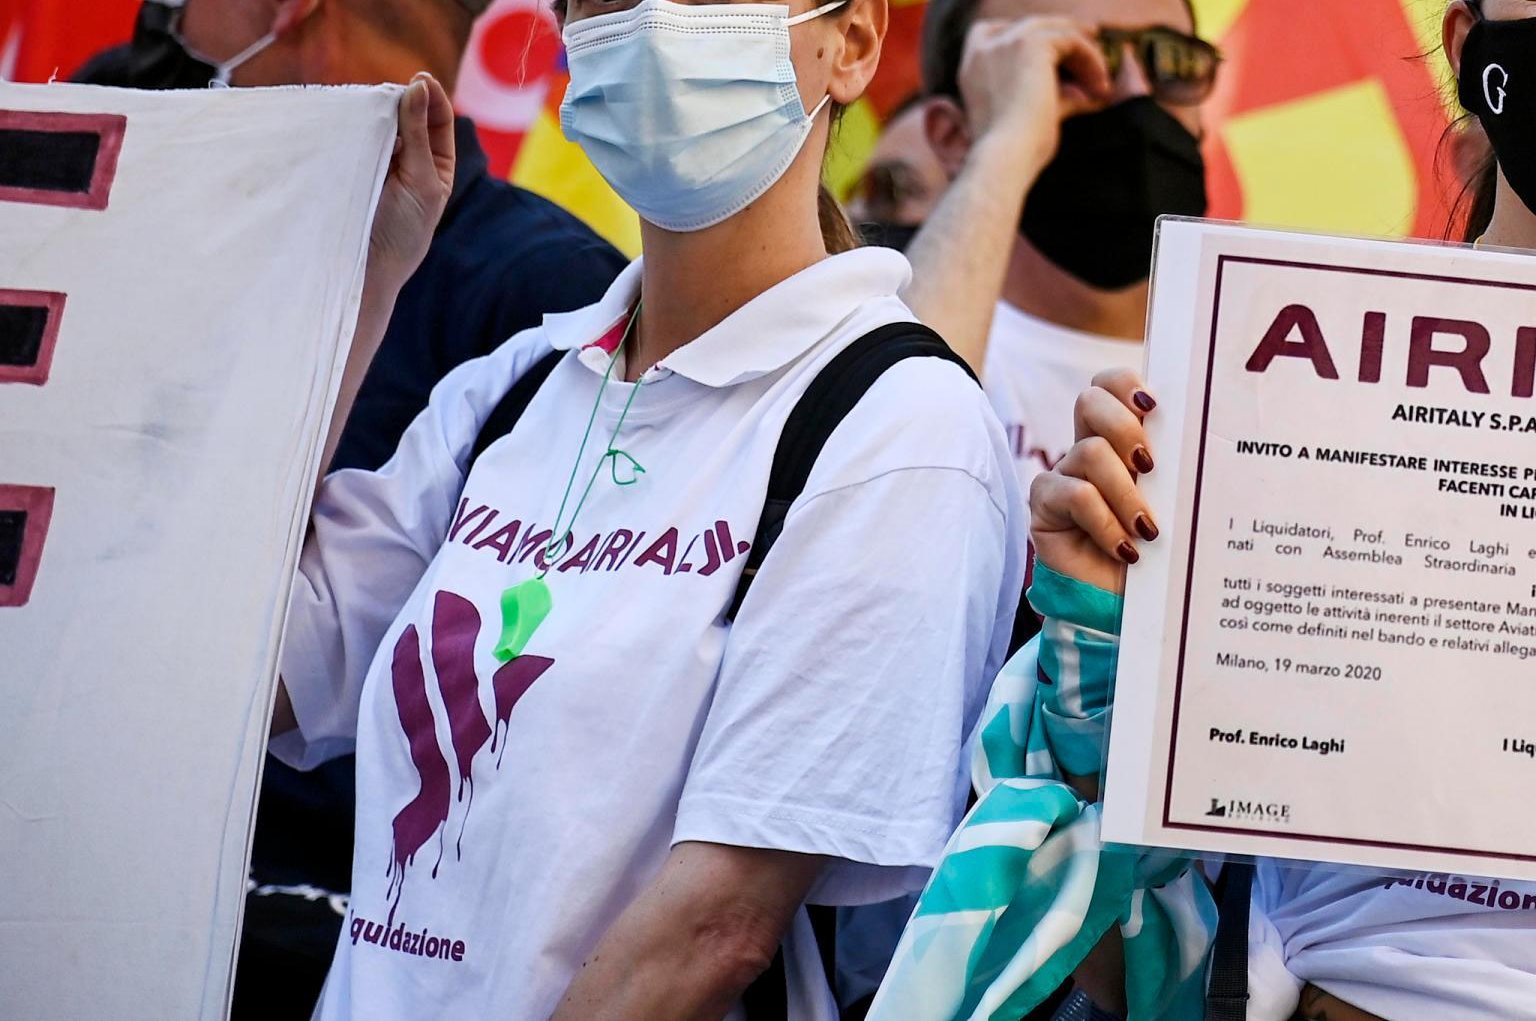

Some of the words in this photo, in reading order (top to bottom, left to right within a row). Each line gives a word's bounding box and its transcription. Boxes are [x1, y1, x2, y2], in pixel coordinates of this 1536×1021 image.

[1390, 403, 1486, 429] AIRITALY
[1235, 439, 1293, 459] INVITO
[1296, 445, 1310, 460] A
[1314, 446, 1428, 472] MANIFESTARE
[1432, 457, 1519, 480] INTERESSE
[1437, 477, 1506, 498] FACENTI
[1499, 502, 1519, 519] IN
[1228, 516, 1234, 531] I
[1251, 518, 1335, 542] Liquidatori,
[1352, 527, 1384, 545] Prof.
[1403, 532, 1451, 552] Enrico
[1468, 539, 1510, 560] Laghi
[1226, 538, 1255, 552] nati
[1274, 543, 1303, 556] con
[1321, 544, 1403, 566] Assemblea
[1423, 553, 1517, 577] Straordinaria
[1222, 576, 1252, 591] tutti
[1255, 581, 1262, 592] i
[1265, 581, 1327, 600] soggetti
[1330, 587, 1405, 605] interessati
[1408, 595, 1419, 607] a
[1422, 596, 1502, 615] presentare
[1220, 594, 1241, 610] ad
[1242, 599, 1304, 616] oggetto
[1305, 600, 1321, 617] le
[1322, 605, 1372, 622] attività
[1374, 611, 1430, 627] inerenti
[1432, 612, 1443, 627] il
[1444, 617, 1496, 633] settore
[1218, 616, 1249, 630] così
[1250, 620, 1294, 635] come
[1295, 620, 1348, 639] definiti
[1350, 626, 1375, 642] nel
[1376, 627, 1426, 647] bando
[1427, 636, 1439, 648] e
[1440, 635, 1490, 653] relativi
[1215, 651, 1269, 673] Milano,
[1274, 656, 1293, 673] 19
[1294, 662, 1341, 678] marzo
[1343, 662, 1383, 682] 2020
[1208, 726, 1246, 745] Prof.
[1248, 730, 1299, 750] Enrico
[1300, 735, 1346, 756] Laghi
[1501, 736, 1509, 752] I
[1228, 799, 1290, 819] IMAGE
